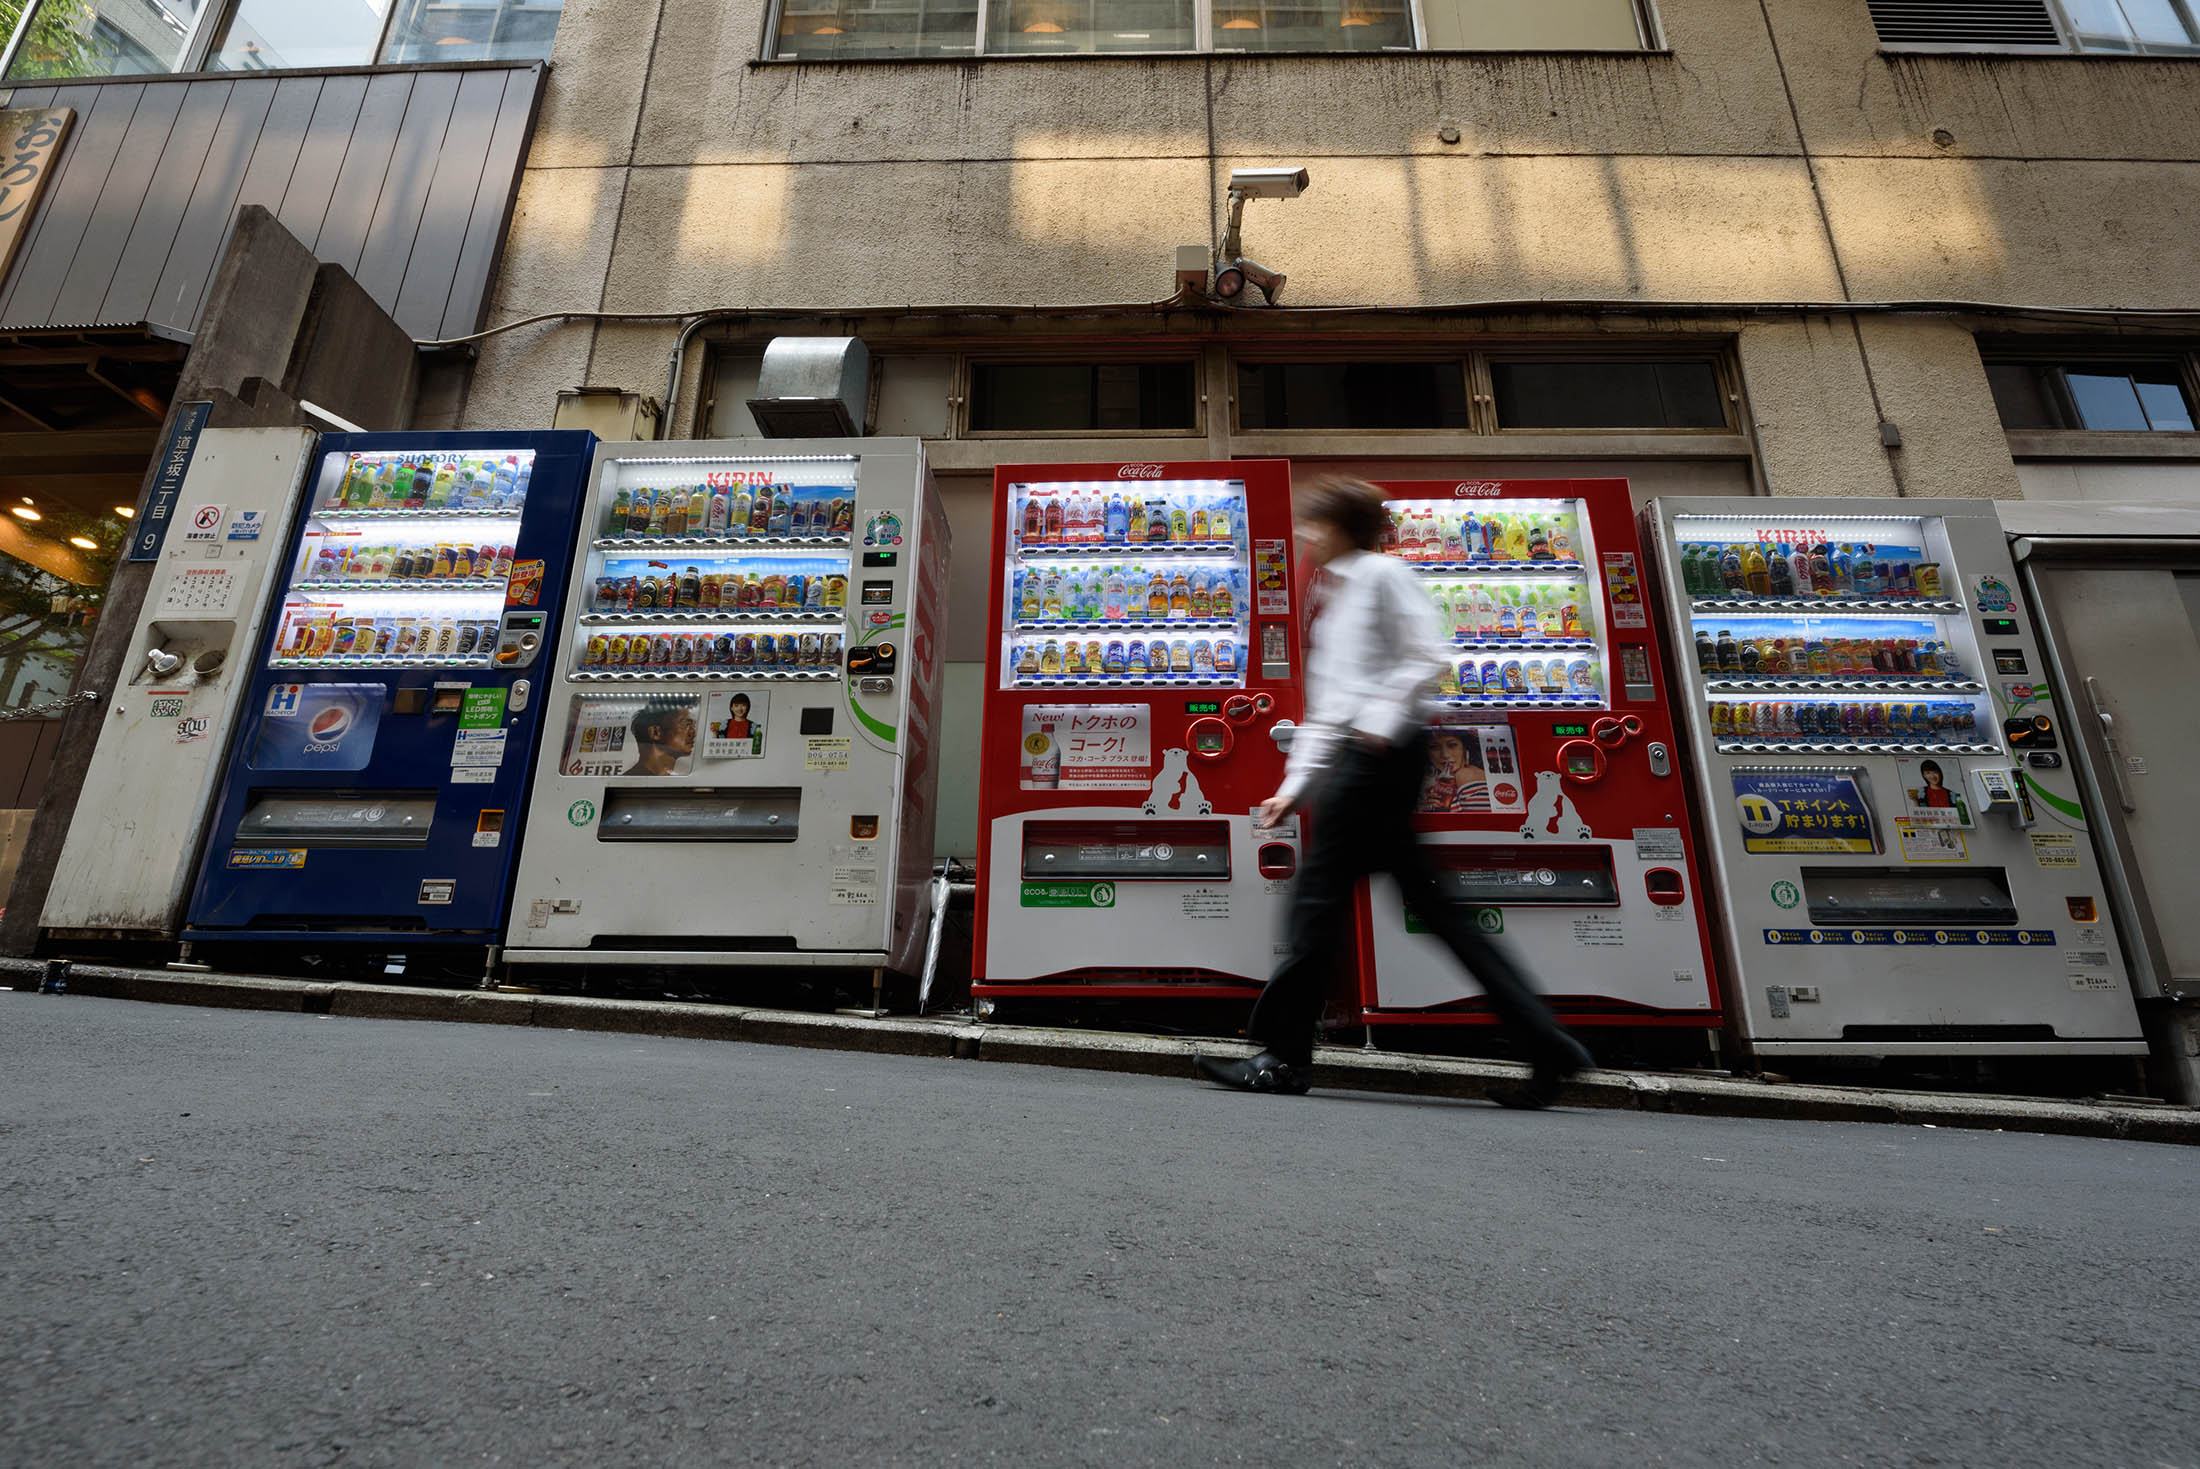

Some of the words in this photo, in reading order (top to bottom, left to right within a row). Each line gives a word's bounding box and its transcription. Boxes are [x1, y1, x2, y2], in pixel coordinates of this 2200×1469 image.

[398, 454, 467, 464] SUNTORY
[152, 436, 193, 519] 道玄坂二丁目
[1117, 464, 1165, 478] Coca-Cola
[707, 472, 774, 487] KIRIN
[1455, 482, 1503, 497] Coca-Cola
[142, 533, 156, 550] 9
[1757, 529, 1828, 544] KIRIN
[1189, 703, 1217, 713] 販売中
[1032, 713, 1065, 722] New!
[1071, 715, 1137, 731] トクホの
[1556, 726, 1584, 735] 販売中
[303, 742, 342, 753] pepsi
[1070, 737, 1126, 752] コーク!
[583, 765, 624, 776] FIRE
[1778, 800, 1850, 812] Tポイント
[1785, 814, 1866, 829] 貯まります!
